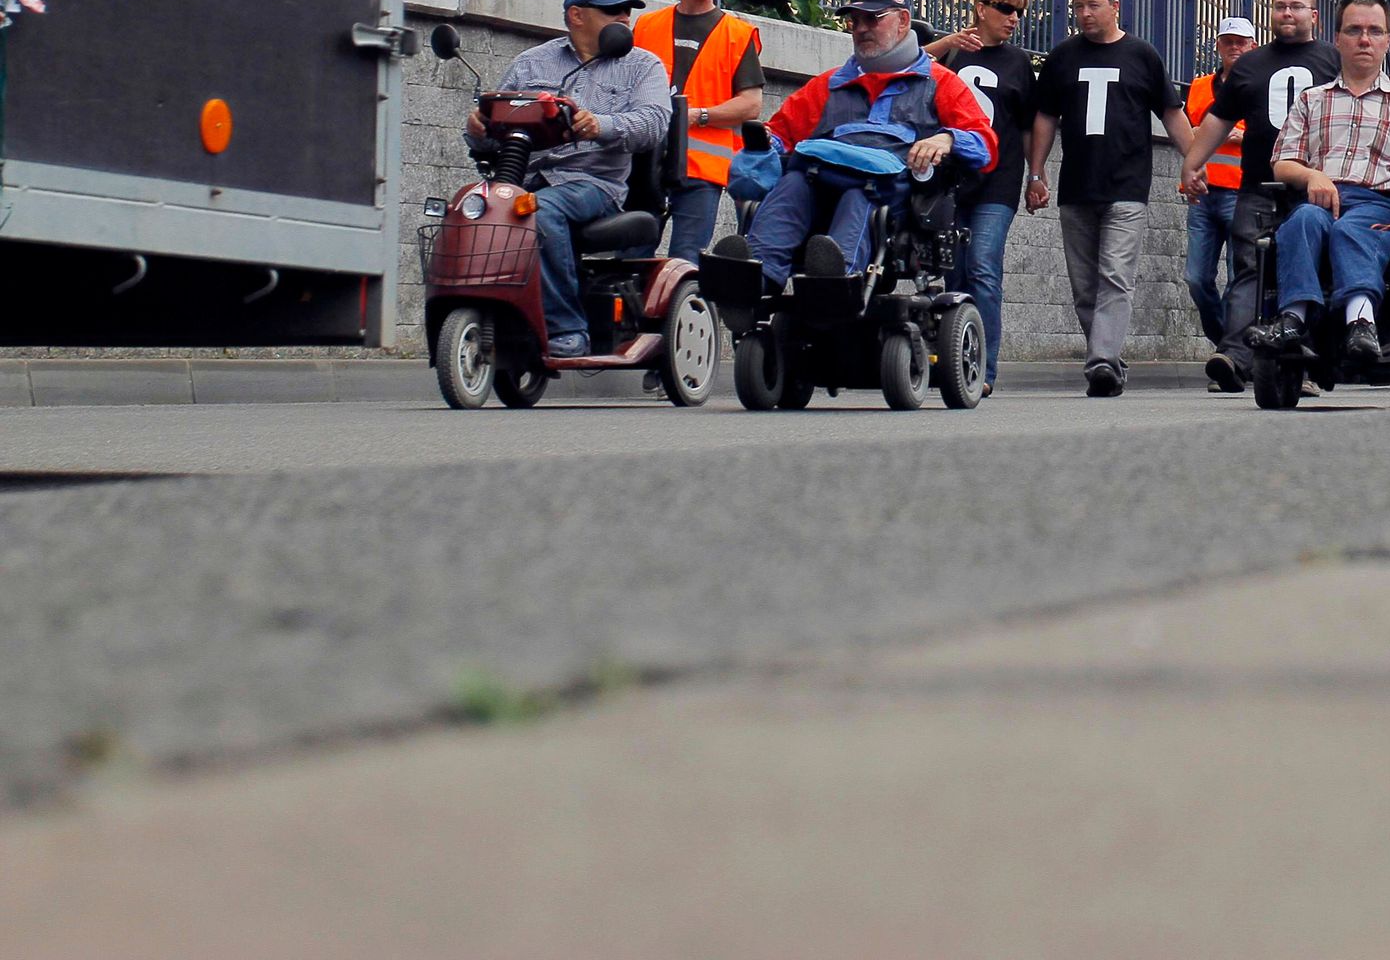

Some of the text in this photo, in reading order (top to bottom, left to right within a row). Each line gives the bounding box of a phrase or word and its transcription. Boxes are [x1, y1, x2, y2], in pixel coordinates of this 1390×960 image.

[957, 66, 998, 128] S
[1078, 68, 1120, 136] T
[1268, 66, 1312, 130] O
